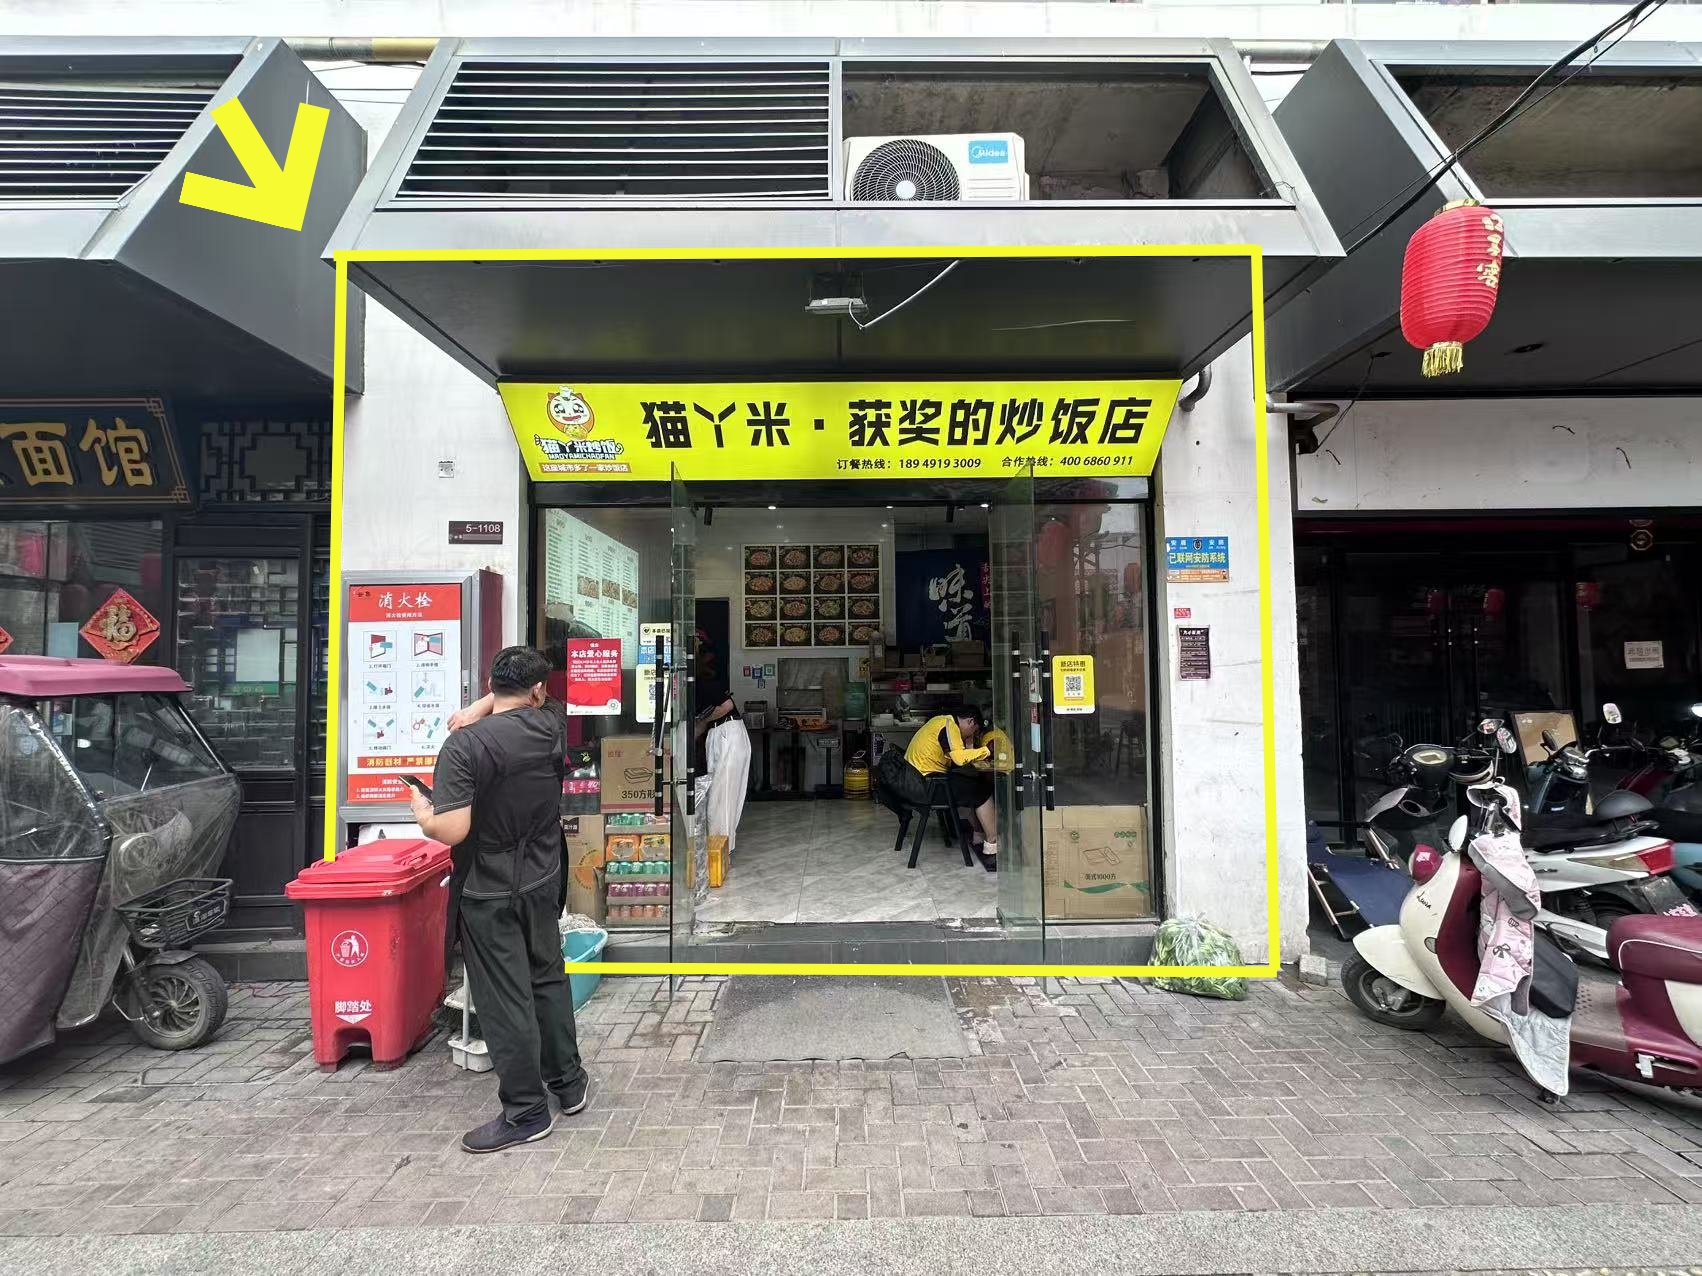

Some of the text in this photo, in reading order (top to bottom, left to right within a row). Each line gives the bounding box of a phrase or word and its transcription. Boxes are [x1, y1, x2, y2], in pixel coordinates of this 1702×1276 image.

[639, 397, 1152, 449] 猫丫米·获奖的炒饭店
[539, 437, 617, 454] 猫丫米炒饭
[466, 524, 501, 533] 5-1108
[1169, 551, 1226, 564] 已联网安防系统
[378, 591, 433, 610] 消火栓
[334, 1000, 373, 1013] 脚踏处
